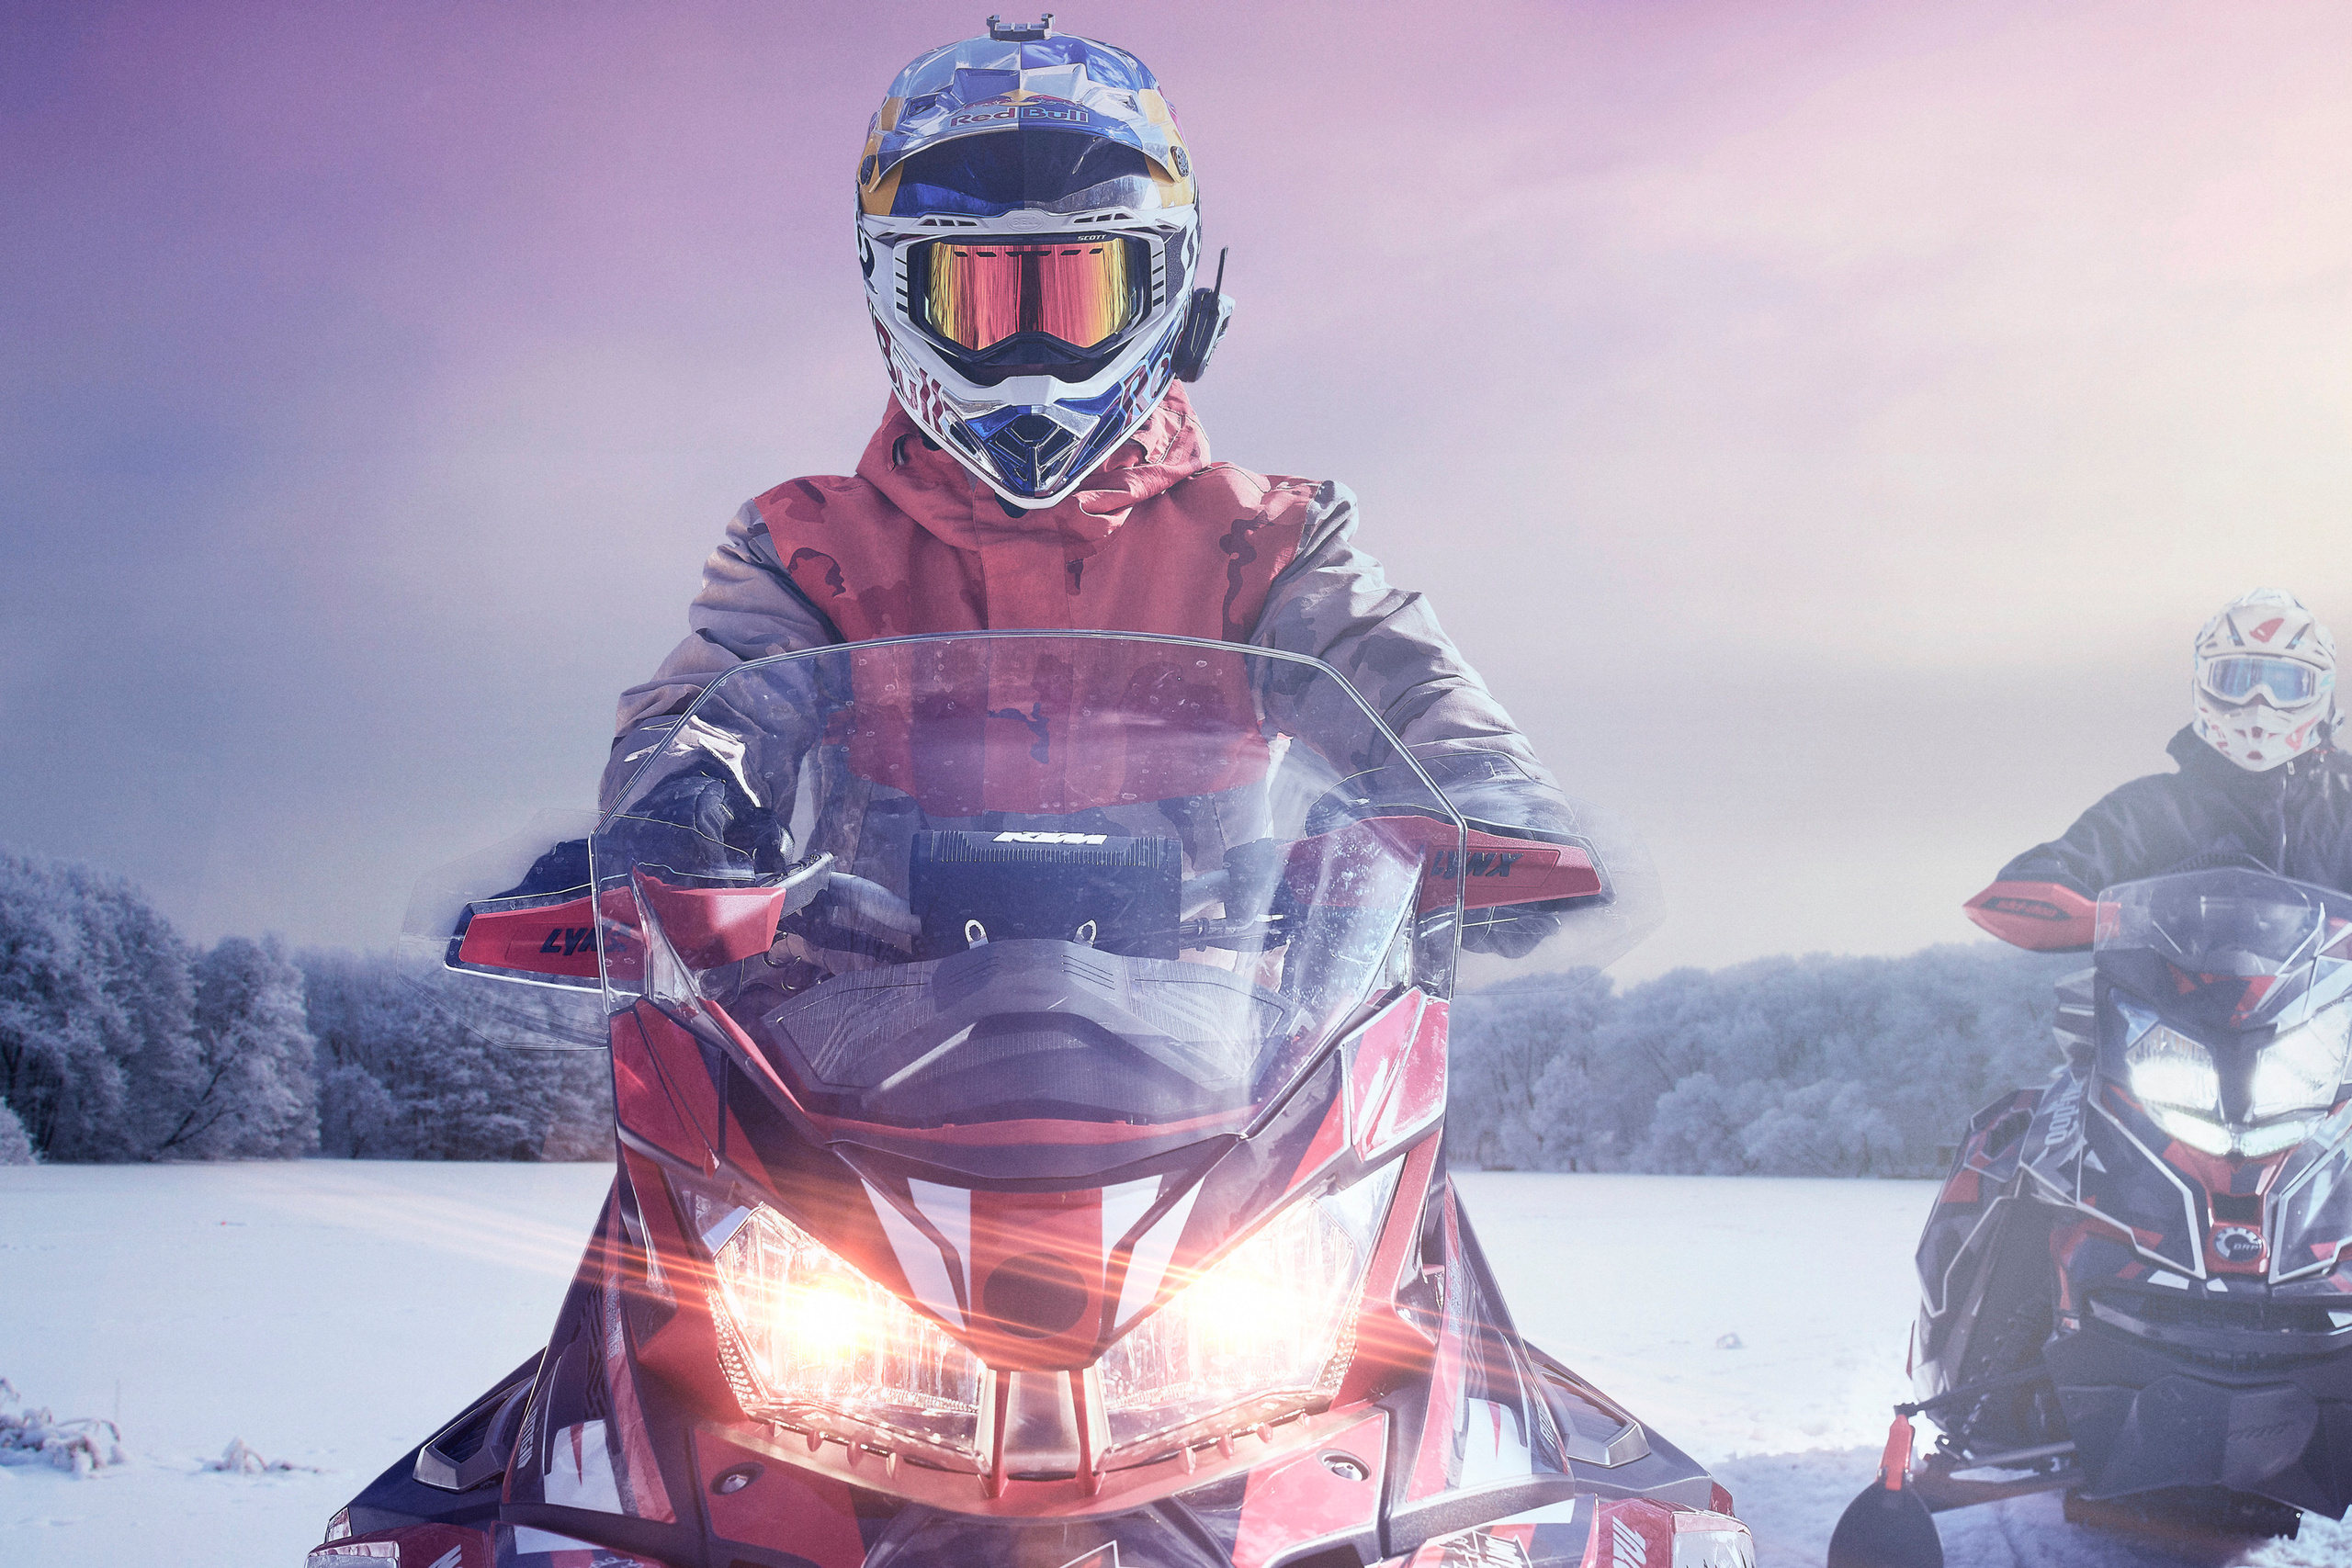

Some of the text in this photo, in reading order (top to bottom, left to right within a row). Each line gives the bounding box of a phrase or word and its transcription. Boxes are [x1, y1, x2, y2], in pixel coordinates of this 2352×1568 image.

[949, 106, 1089, 128] Red Bull
[1077, 233, 1107, 242] SCOTT
[991, 830, 1108, 845] KTM
[1430, 850, 1524, 879] LYNX
